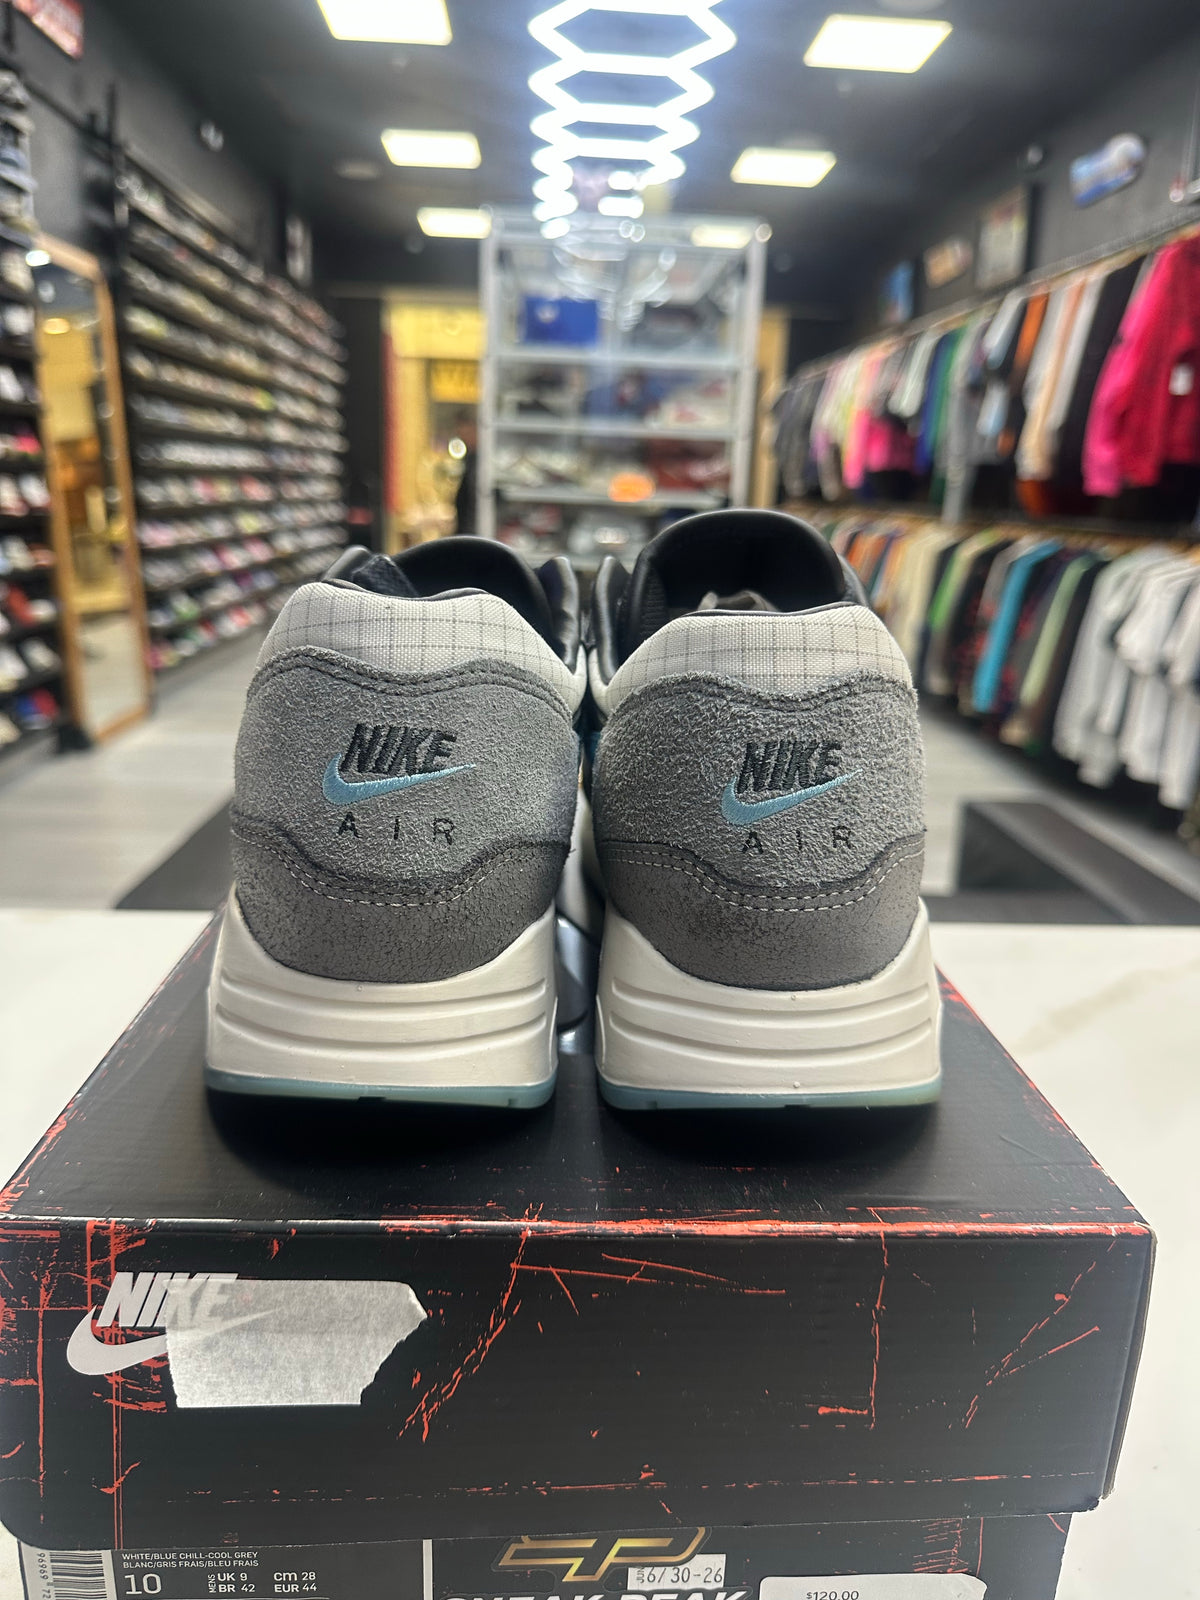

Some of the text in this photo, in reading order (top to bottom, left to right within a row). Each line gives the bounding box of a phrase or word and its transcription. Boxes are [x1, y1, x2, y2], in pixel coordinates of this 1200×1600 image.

[338, 723, 458, 776] NIKE
[736, 739, 842, 794] NIKE
[121, 1551, 259, 1560] WHITE/BLUE CHILL-COOL GREY
[123, 1559, 259, 1569] BLANC/GRIS FRAIS/BLEU FRAIS
[217, 1572, 248, 1582] UK 9
[273, 1572, 316, 1581] cm 28
[124, 1573, 162, 1595] 10
[207, 1574, 216, 1593] MENS
[218, 1583, 256, 1593] BR 42
[274, 1583, 317, 1593] EUR 44
